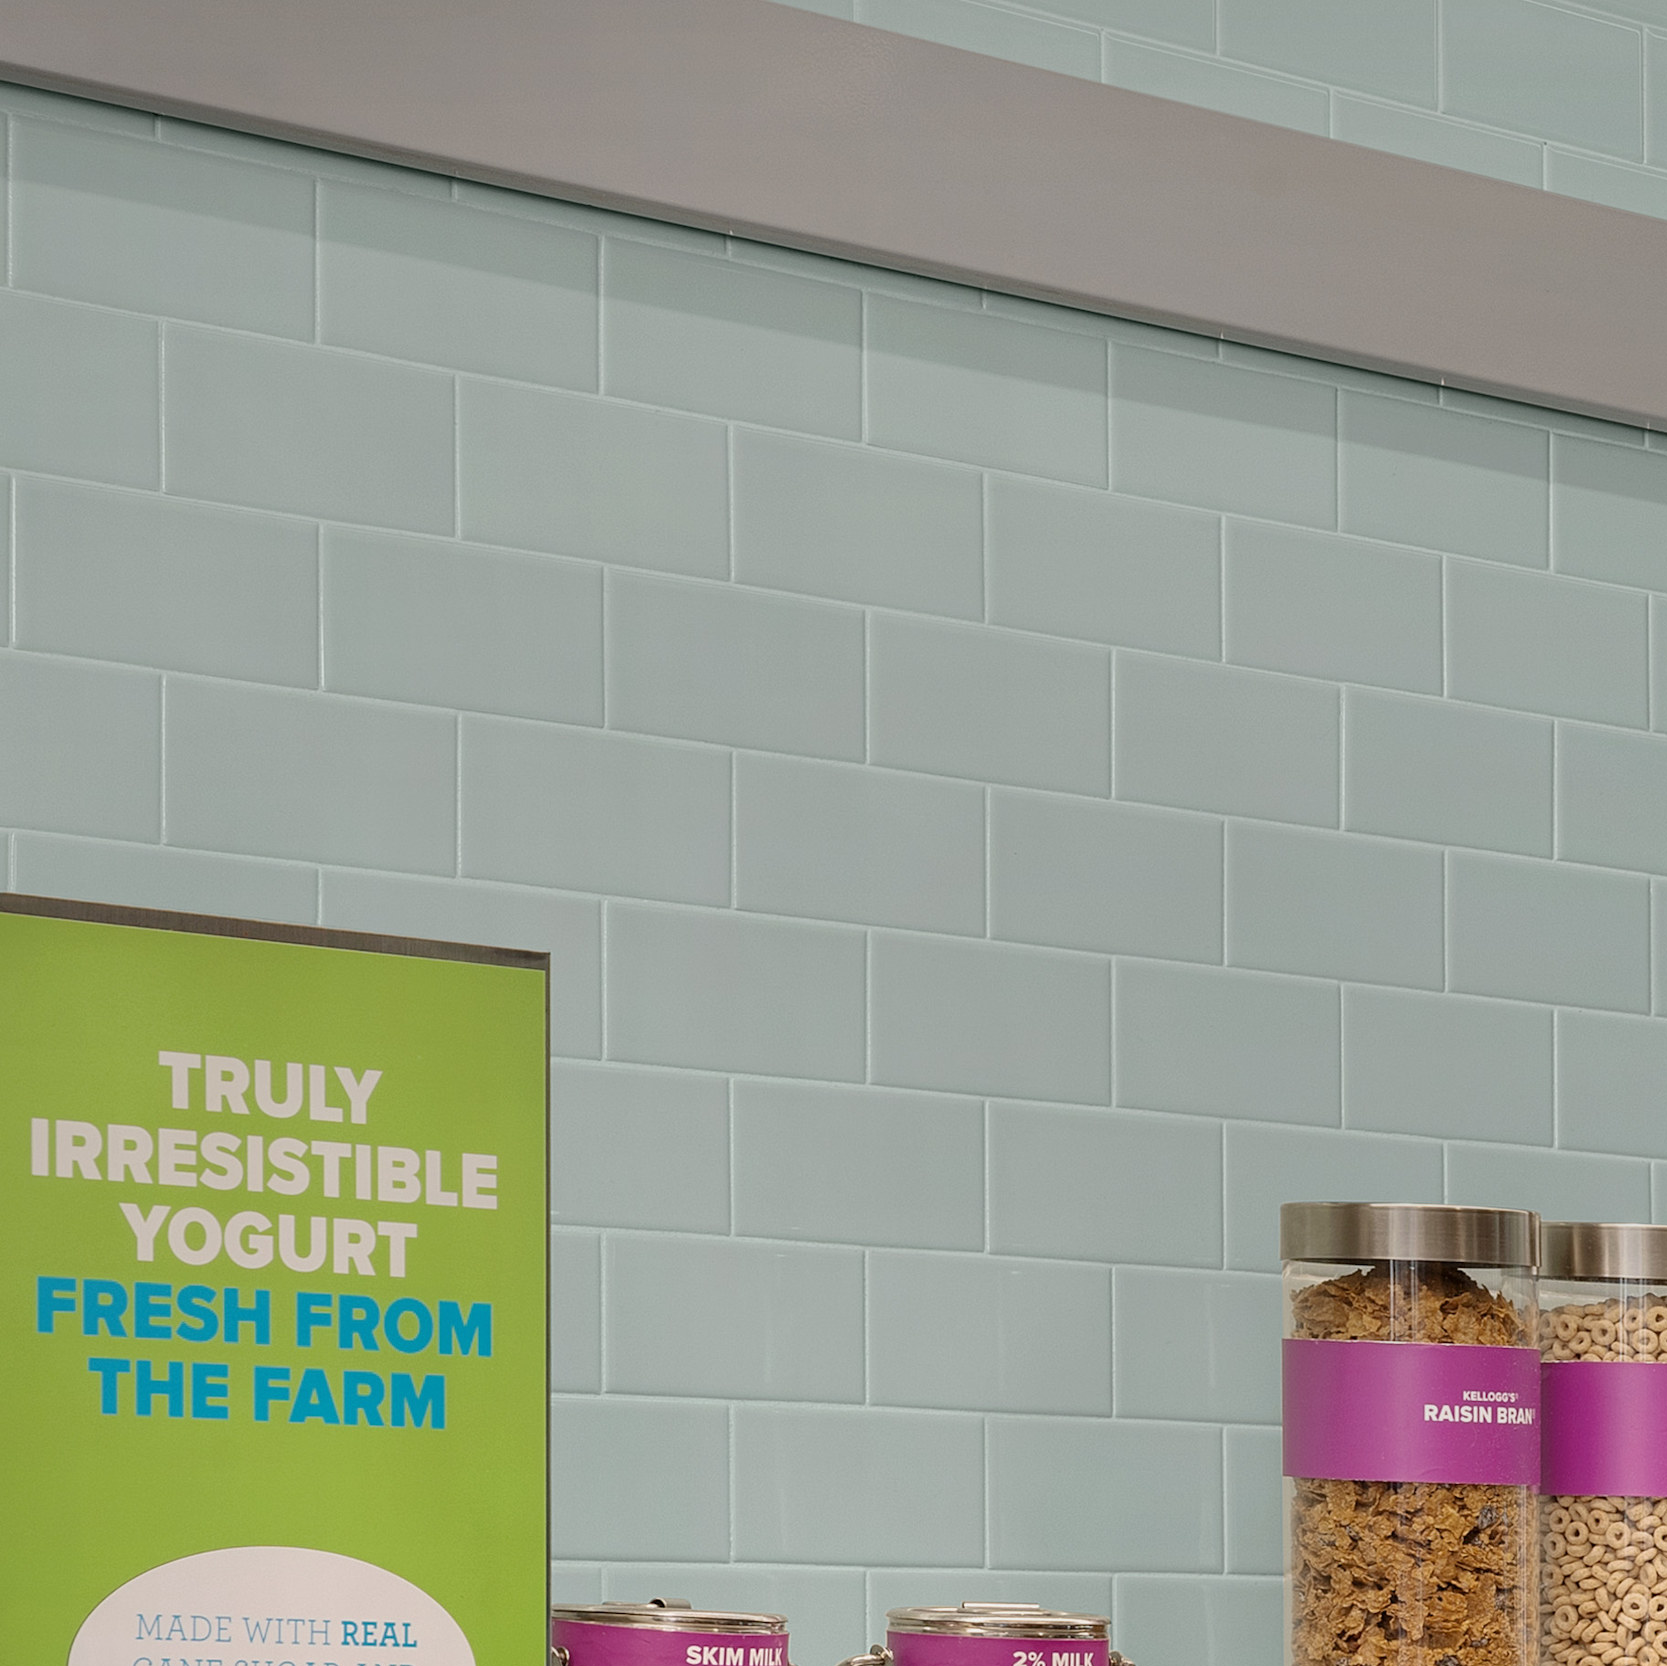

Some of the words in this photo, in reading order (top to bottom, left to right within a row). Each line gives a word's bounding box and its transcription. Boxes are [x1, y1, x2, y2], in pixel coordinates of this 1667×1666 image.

[158, 1050, 383, 1125] TRULY
[31, 1117, 498, 1210] IRRESISTIBLE
[118, 1202, 418, 1278] YOGURT
[36, 1275, 271, 1345] FRESH
[296, 1292, 493, 1358] FROM
[88, 1357, 229, 1420] THE
[253, 1365, 446, 1430] FARM
[1424, 1404, 1492, 1423] RAISIN
[135, 1613, 232, 1644] MADE
[242, 1616, 332, 1647] WITH
[340, 1620, 418, 1648] REAL
